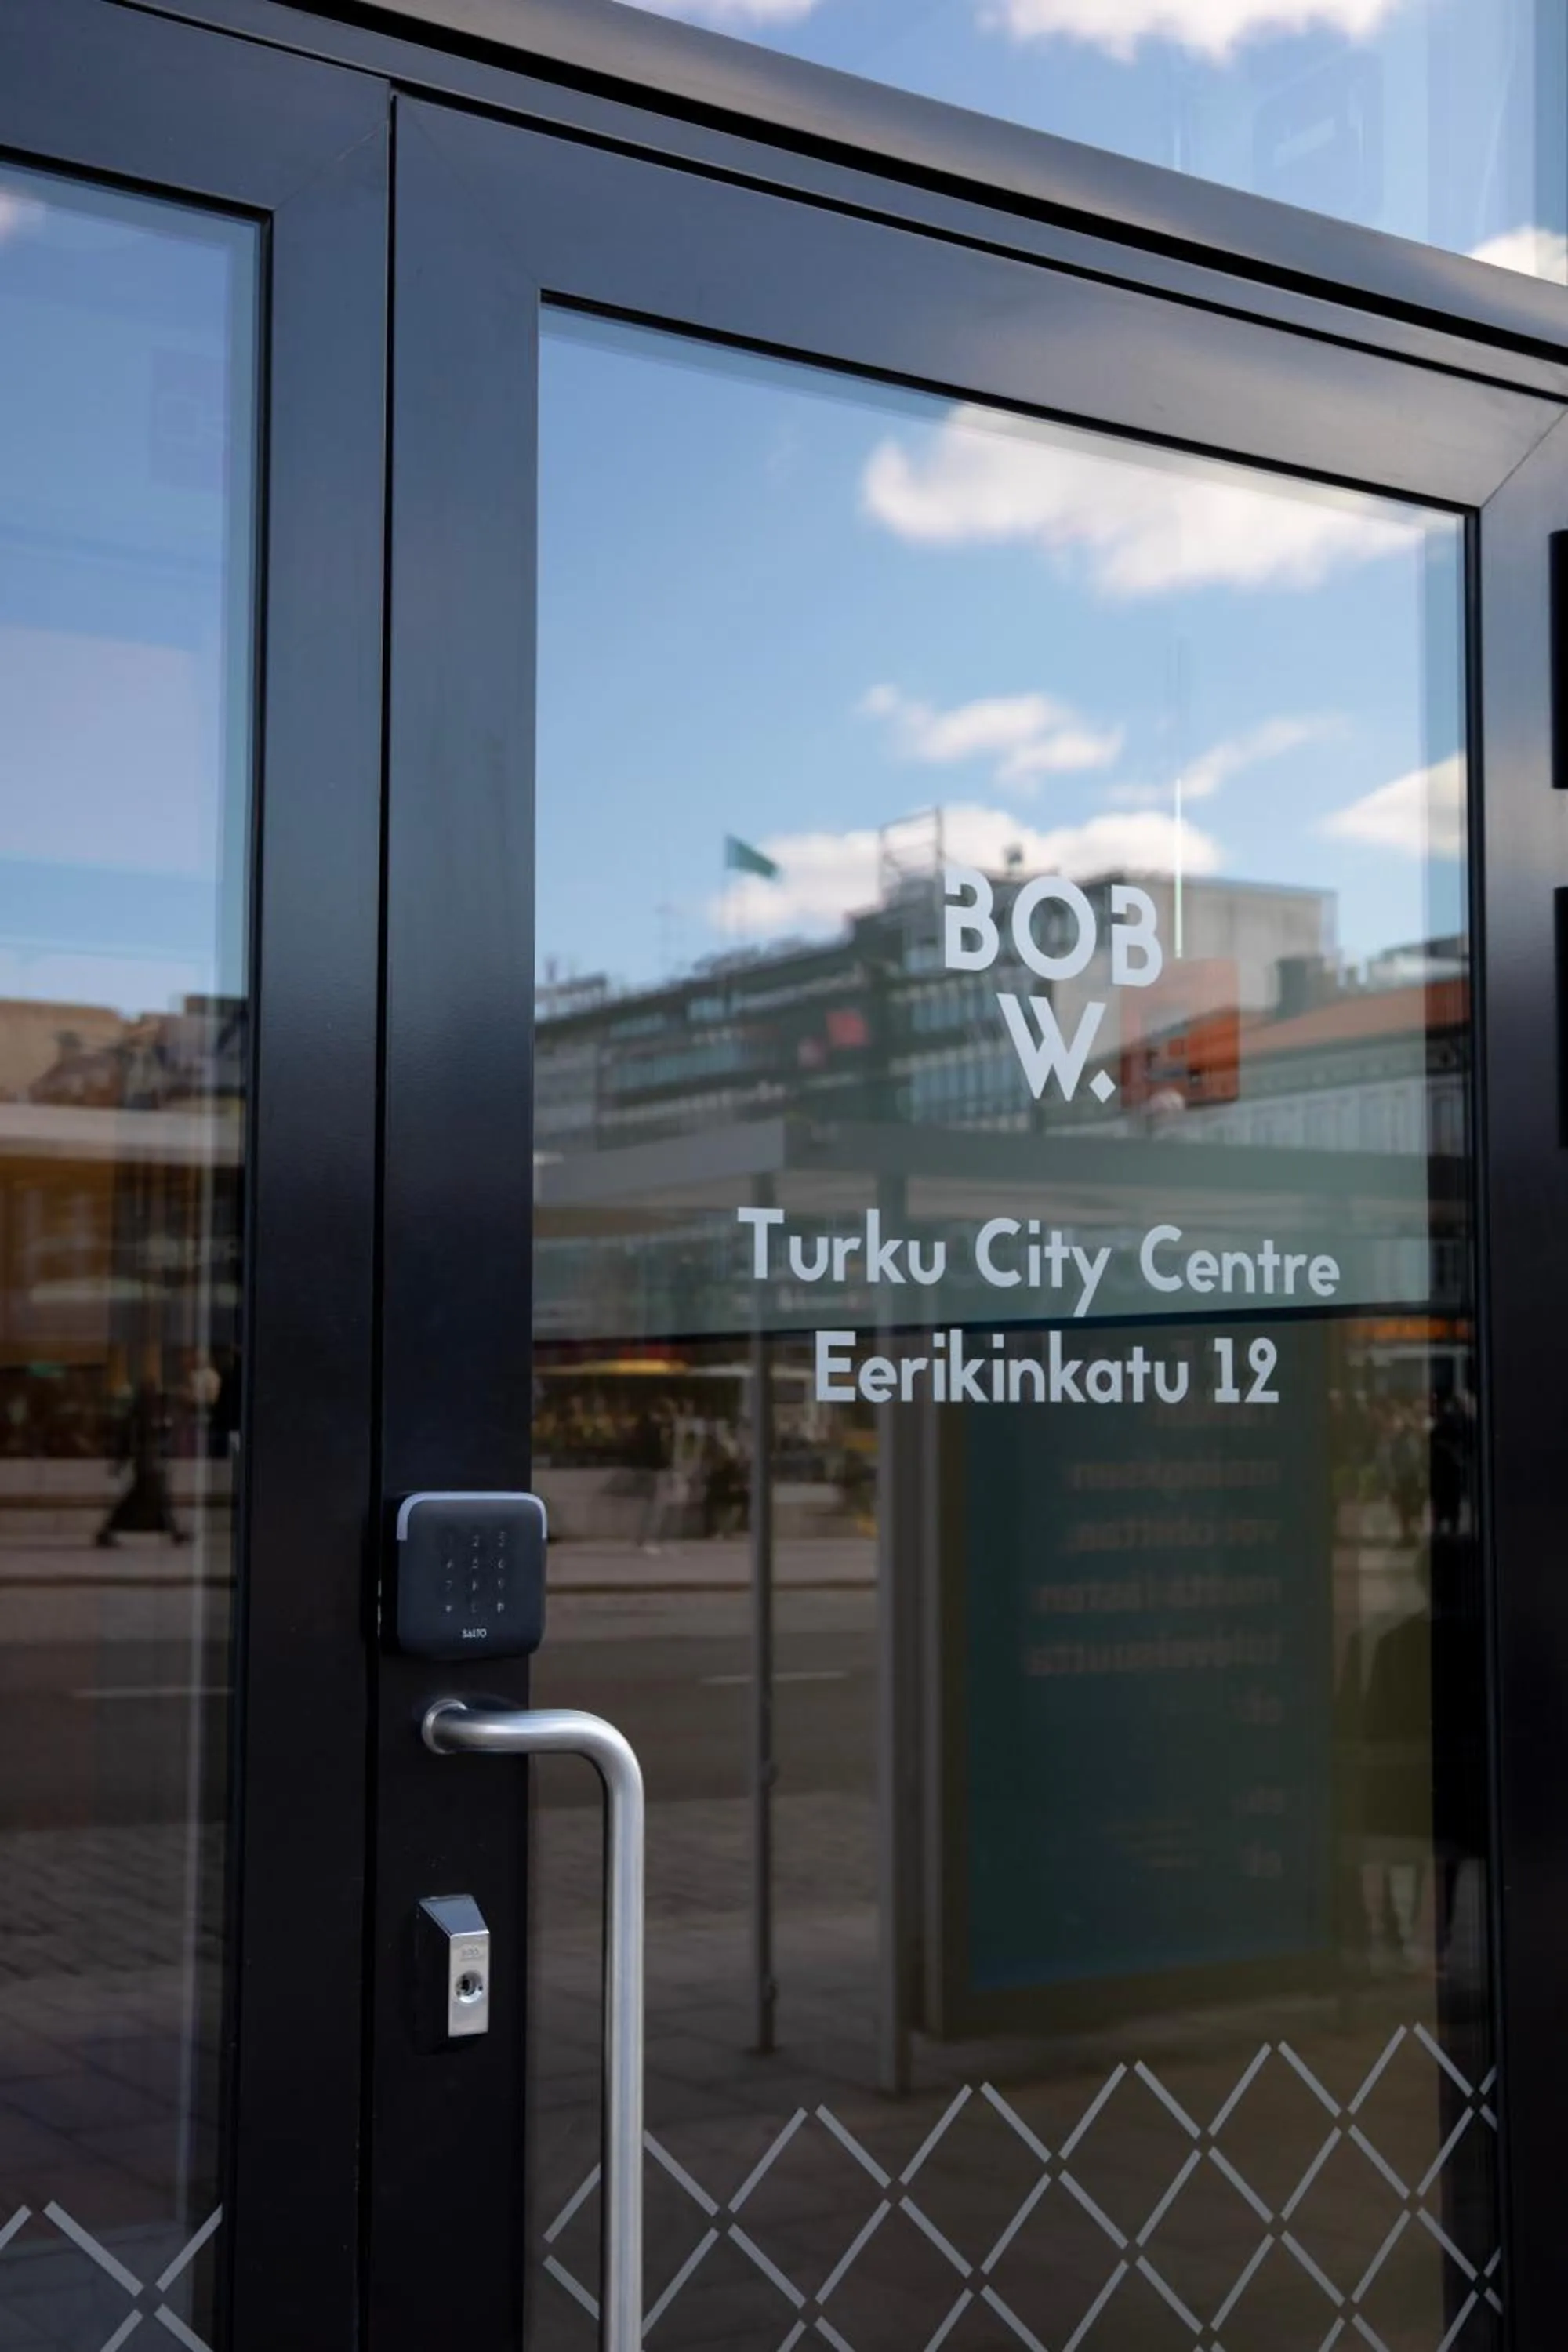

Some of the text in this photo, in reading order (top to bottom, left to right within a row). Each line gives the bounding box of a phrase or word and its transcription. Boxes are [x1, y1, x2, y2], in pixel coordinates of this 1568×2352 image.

[943, 863, 1163, 988] BOB
[996, 993, 1116, 1103] W.
[737, 1207, 1340, 1317] Turku City Centre
[815, 1329, 1279, 1404] Eerikinkatu 12
